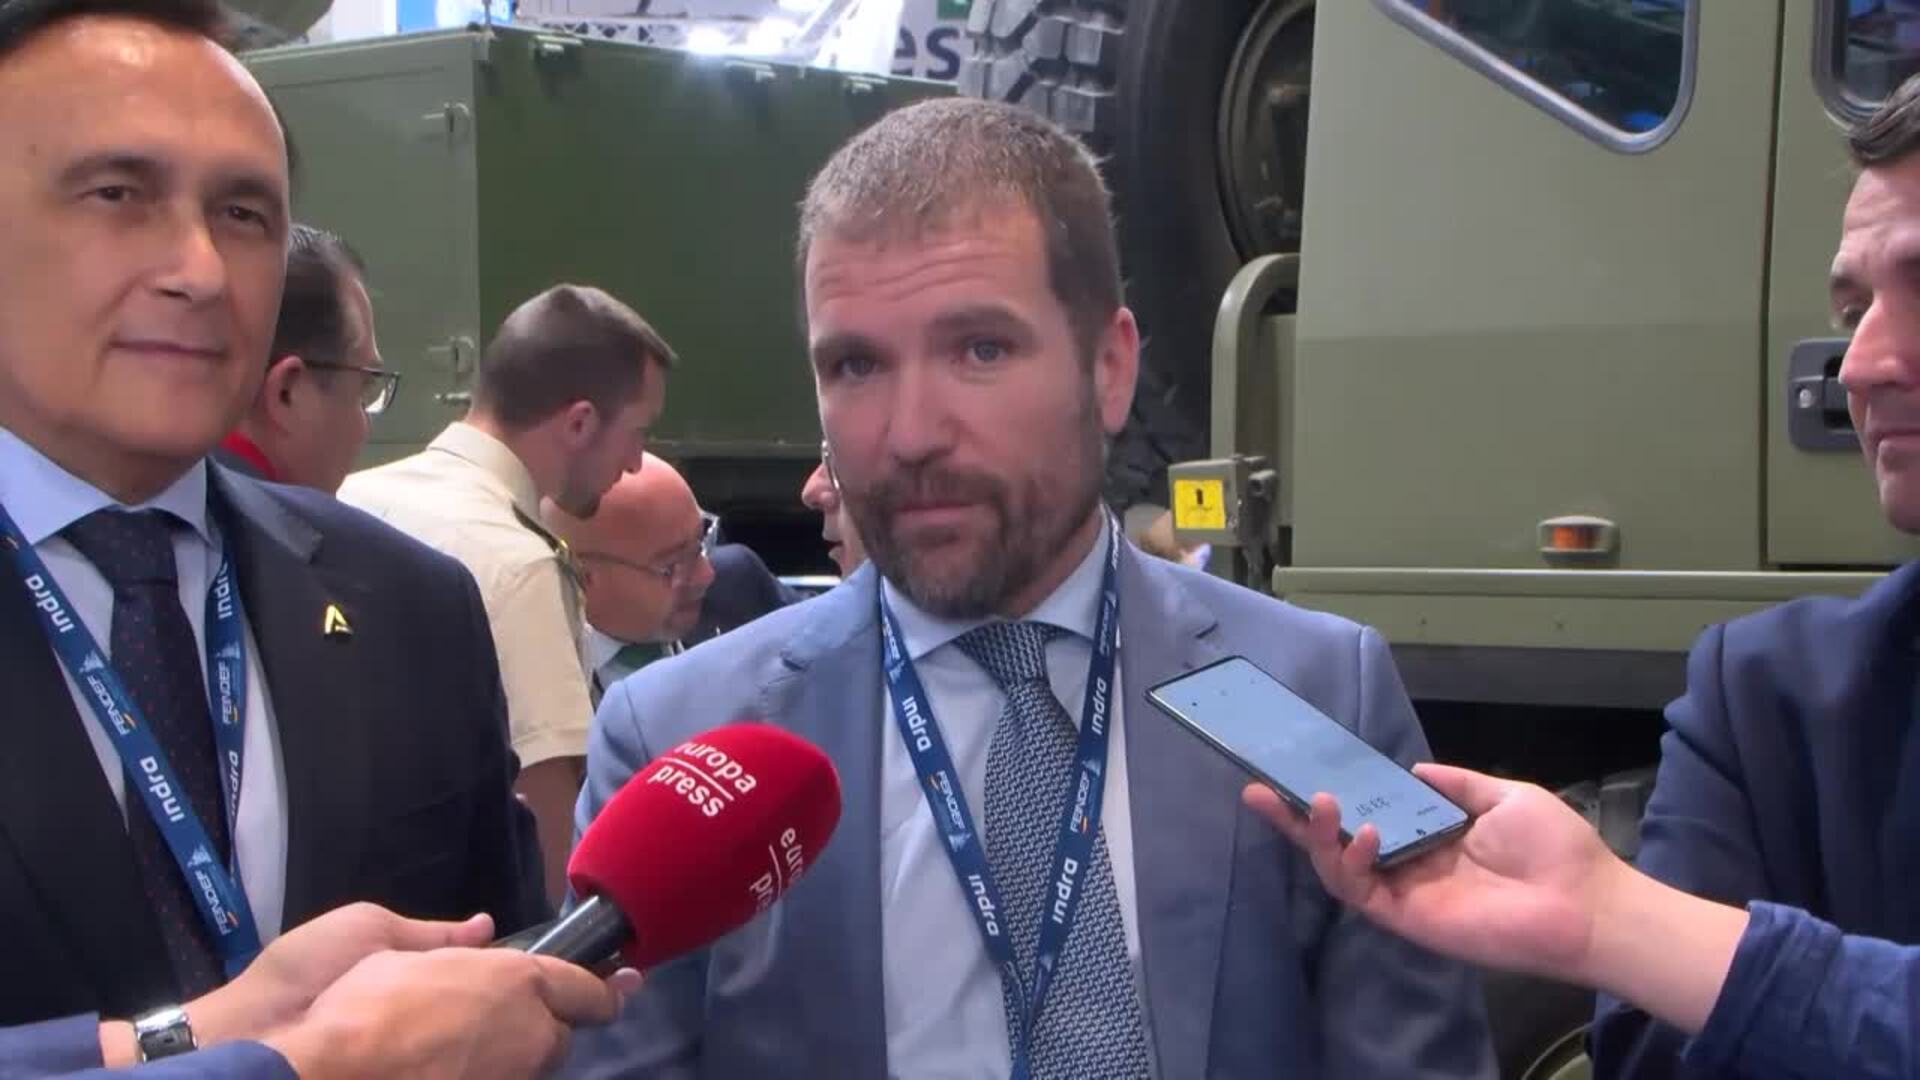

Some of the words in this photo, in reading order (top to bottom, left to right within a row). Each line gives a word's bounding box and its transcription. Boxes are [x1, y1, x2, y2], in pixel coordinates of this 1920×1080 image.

[25, 574, 74, 632] indra
[902, 696, 932, 752] indra
[1091, 677, 1107, 735] indra
[139, 756, 185, 823] indra
[647, 765, 724, 817] press
[968, 874, 1000, 936] indra
[1052, 856, 1079, 924] indra
